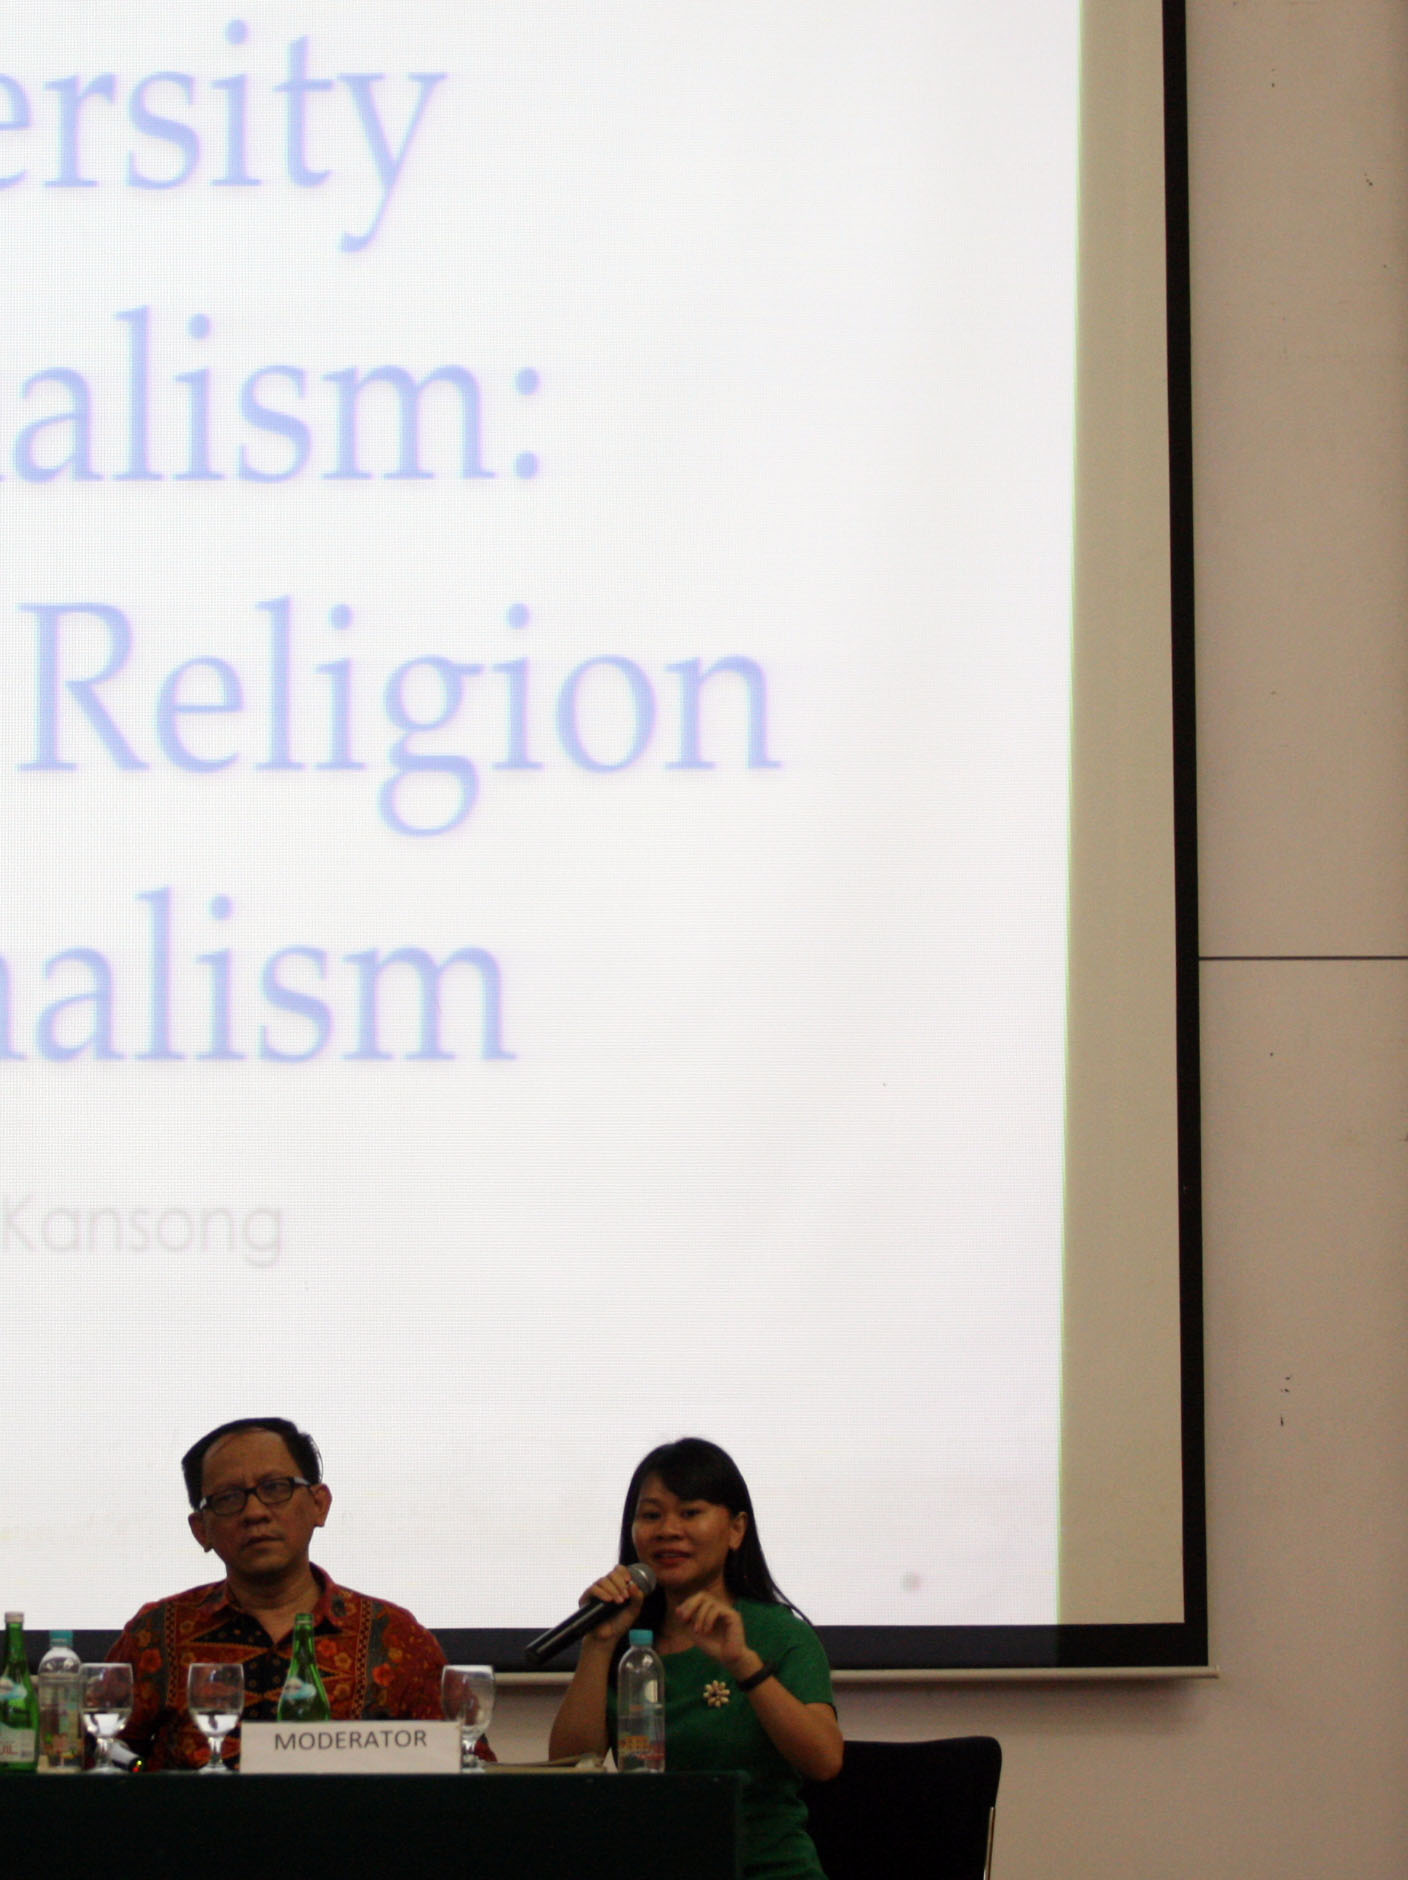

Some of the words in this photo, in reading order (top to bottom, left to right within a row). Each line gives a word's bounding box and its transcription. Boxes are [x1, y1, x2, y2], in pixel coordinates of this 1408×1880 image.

[16, 595, 781, 837] Religion
[0, 1193, 286, 1269] Kansong
[275, 1730, 427, 1750] MODERATOR
